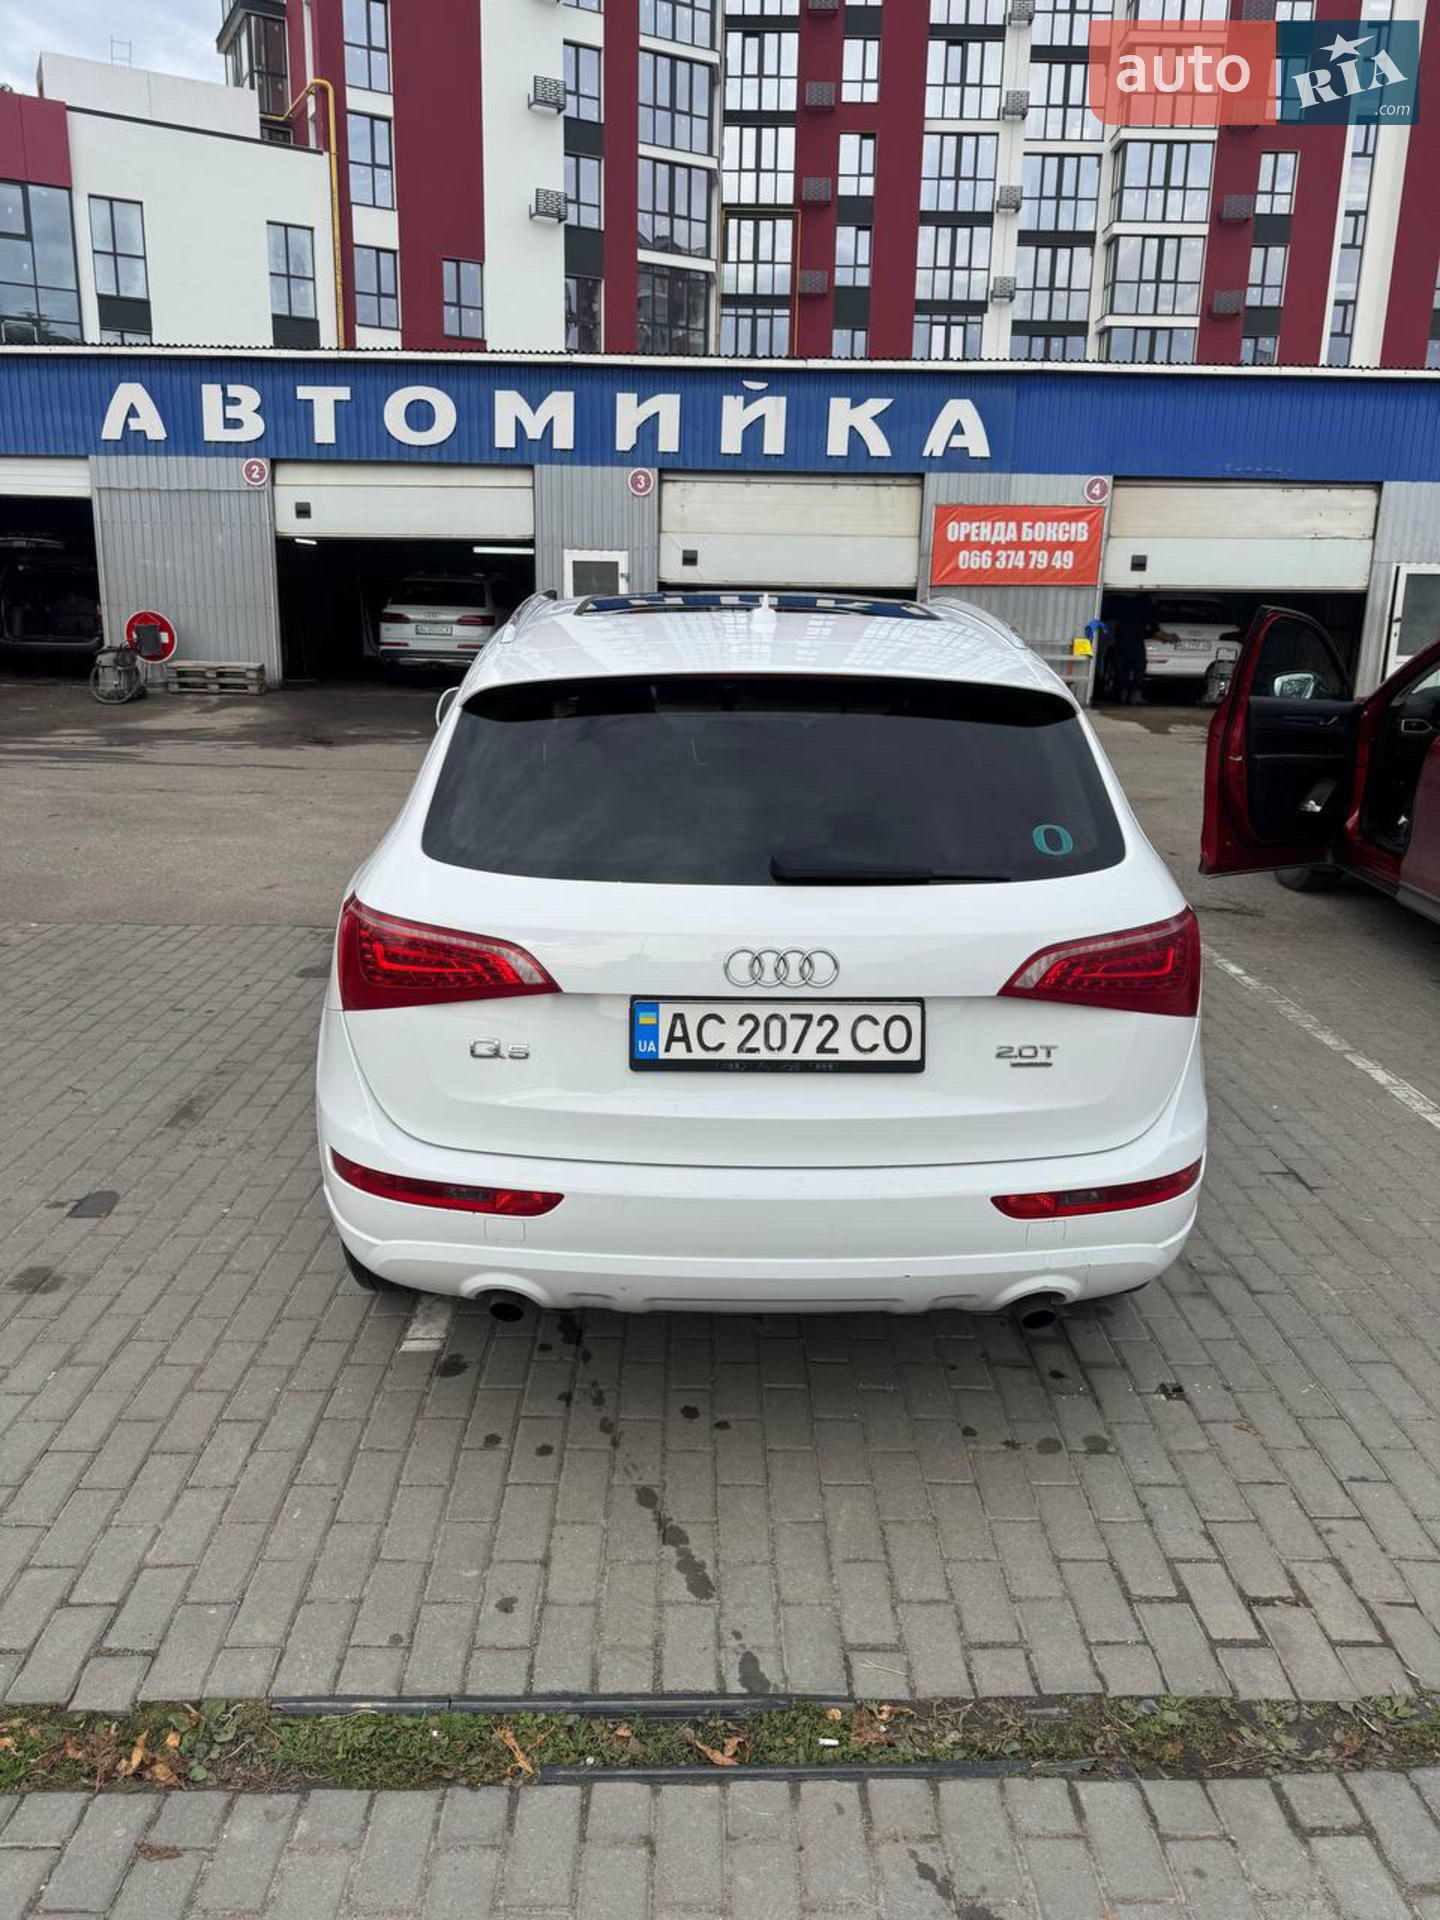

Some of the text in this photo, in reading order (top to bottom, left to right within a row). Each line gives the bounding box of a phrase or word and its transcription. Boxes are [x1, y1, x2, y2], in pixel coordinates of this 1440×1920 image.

[100, 379, 992, 459] АВТОМИЙКА
[947, 521, 1089, 545] ОРЕНДА БОКСІВ
[958, 550, 1075, 570] 066 374 79 49
[664, 1012, 913, 1055] AC 2072 CO
[469, 1037, 529, 1060] Q5
[638, 1040, 657, 1053] UA
[995, 1044, 1059, 1059] 2.0T
